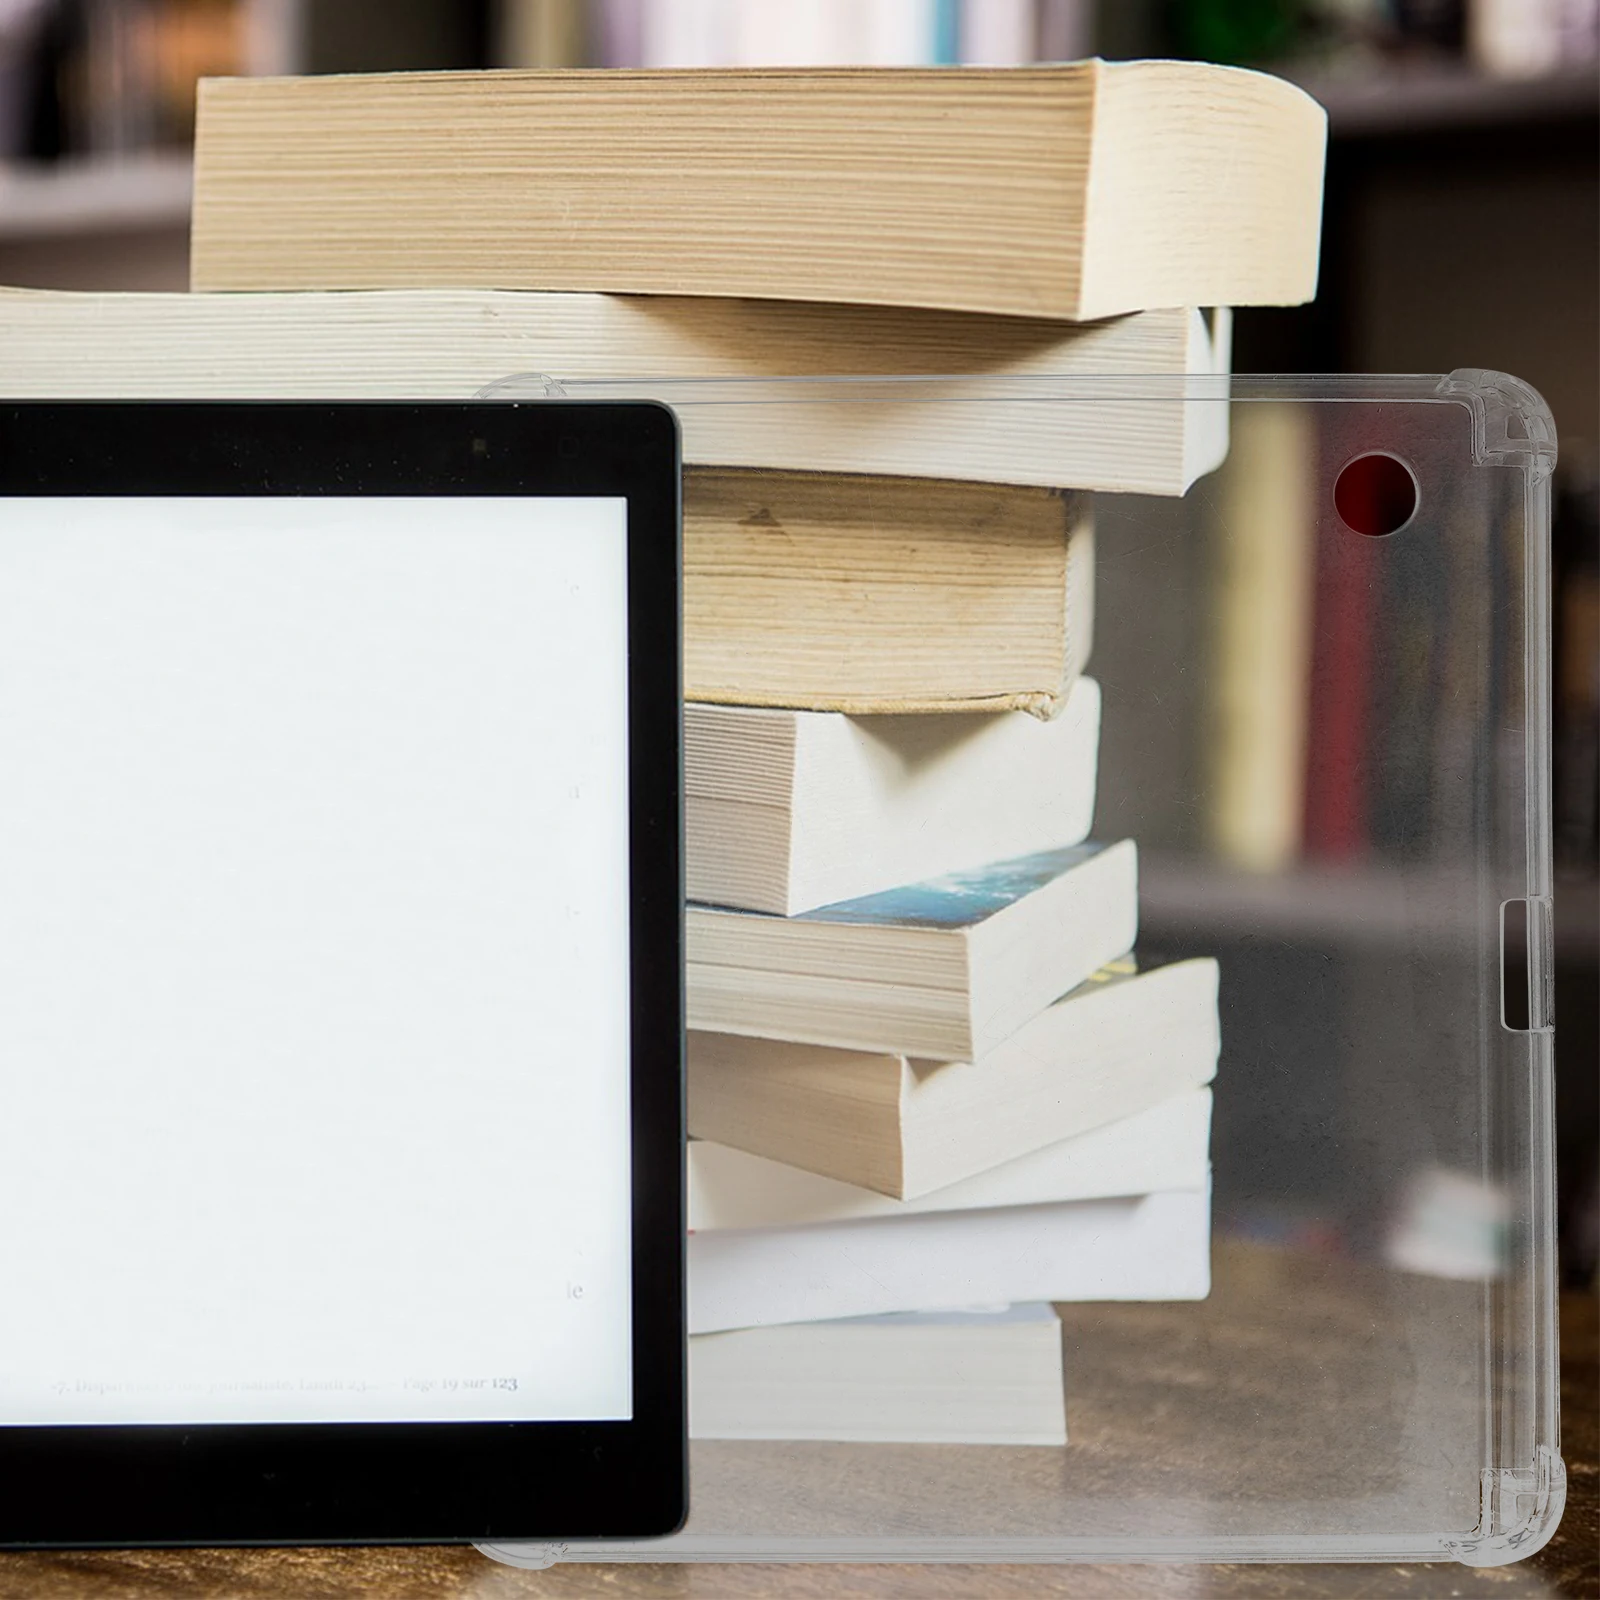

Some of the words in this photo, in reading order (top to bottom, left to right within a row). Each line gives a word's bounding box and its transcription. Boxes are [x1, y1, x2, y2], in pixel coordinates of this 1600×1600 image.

[442, 1379, 459, 1392] 19
[462, 1379, 489, 1390] sur
[491, 1377, 518, 1392] 123
